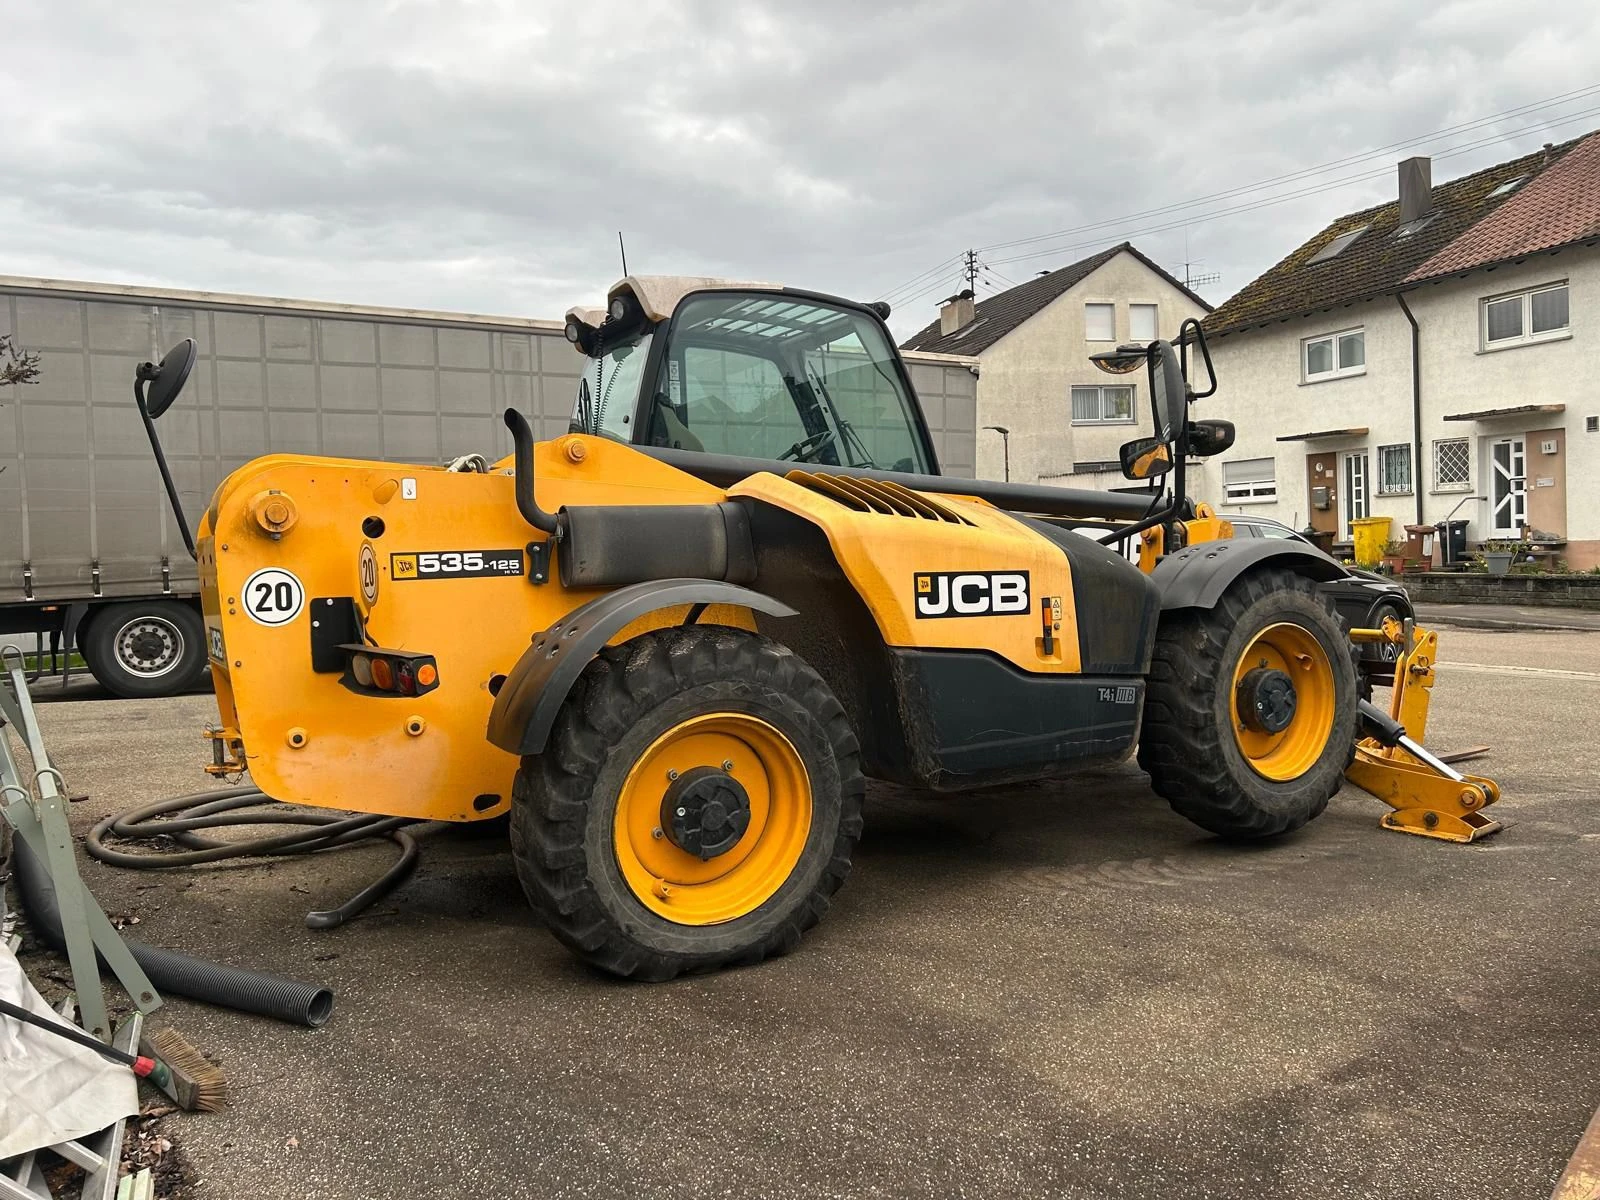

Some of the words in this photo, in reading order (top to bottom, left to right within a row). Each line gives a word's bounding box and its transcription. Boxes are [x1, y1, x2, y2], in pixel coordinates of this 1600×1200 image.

[363, 557, 374, 587] 20
[419, 553, 519, 573] 535-125
[255, 582, 293, 612] 20
[918, 575, 1027, 614] JCB
[1098, 687, 1115, 702] T4i
